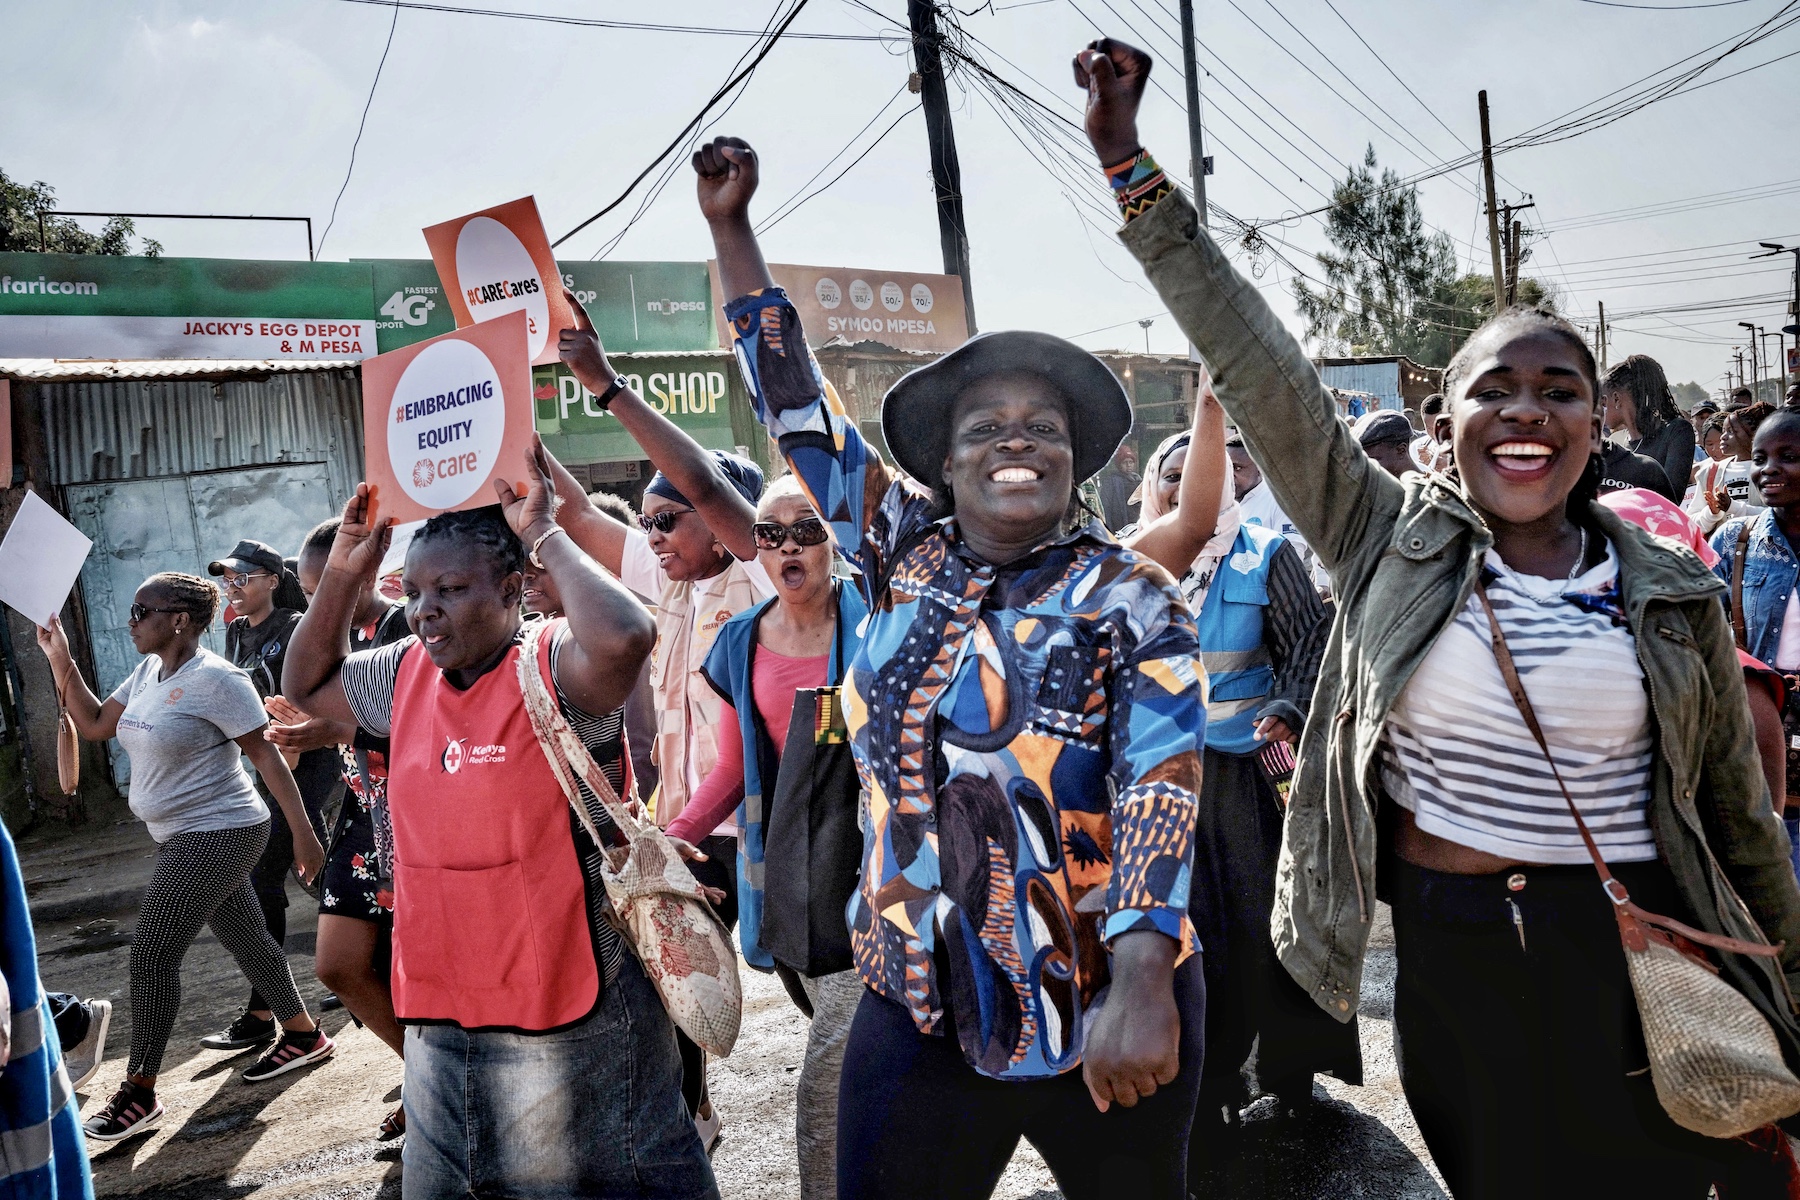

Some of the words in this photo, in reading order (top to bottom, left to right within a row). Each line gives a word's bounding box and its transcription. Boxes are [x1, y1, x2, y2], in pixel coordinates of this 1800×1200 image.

[0, 275, 98, 295] faricom
[404, 286, 438, 294] FASTEST
[467, 278, 539, 306] #CARECares
[380, 291, 435, 326] 4G+
[183, 322, 254, 336] JACKY'S
[260, 323, 298, 337] EGG
[305, 324, 361, 337] DEPOT
[375, 321, 404, 329] OPOTE
[827, 316, 883, 333] SYMOO
[886, 318, 937, 334] MPESA
[280, 340, 293, 353] &
[299, 340, 315, 353] M
[321, 341, 363, 353] PESA
[396, 380, 493, 423] #EMBRACING
[648, 371, 725, 415] SHOP
[418, 419, 473, 450] EQUITY
[437, 451, 477, 479] care
[120, 718, 140, 728] omen's
[140, 721, 154, 732] Day
[472, 744, 506, 755] Kenya
[469, 756, 484, 764] Red
